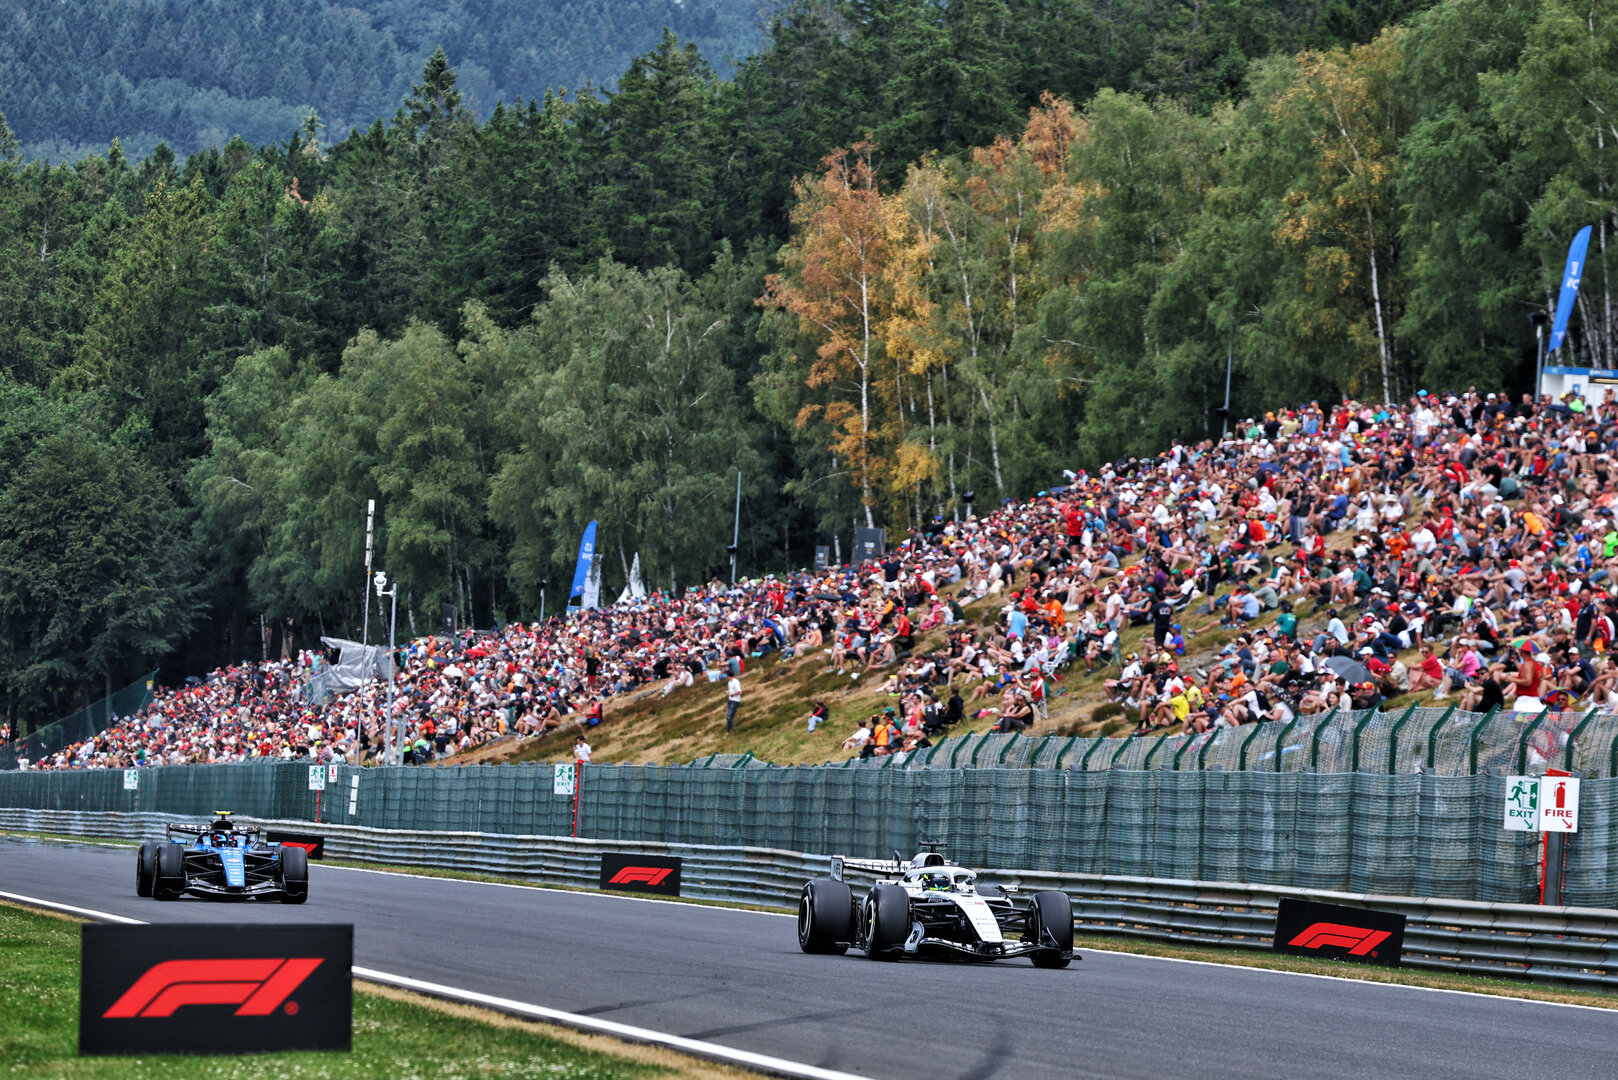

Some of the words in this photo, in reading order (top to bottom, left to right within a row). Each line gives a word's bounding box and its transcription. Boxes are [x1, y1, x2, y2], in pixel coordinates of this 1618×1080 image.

[1509, 809, 1534, 818] EXIT
[1545, 809, 1573, 817] FIRE
[1287, 922, 1393, 956] F1
[102, 957, 325, 1018] F1
